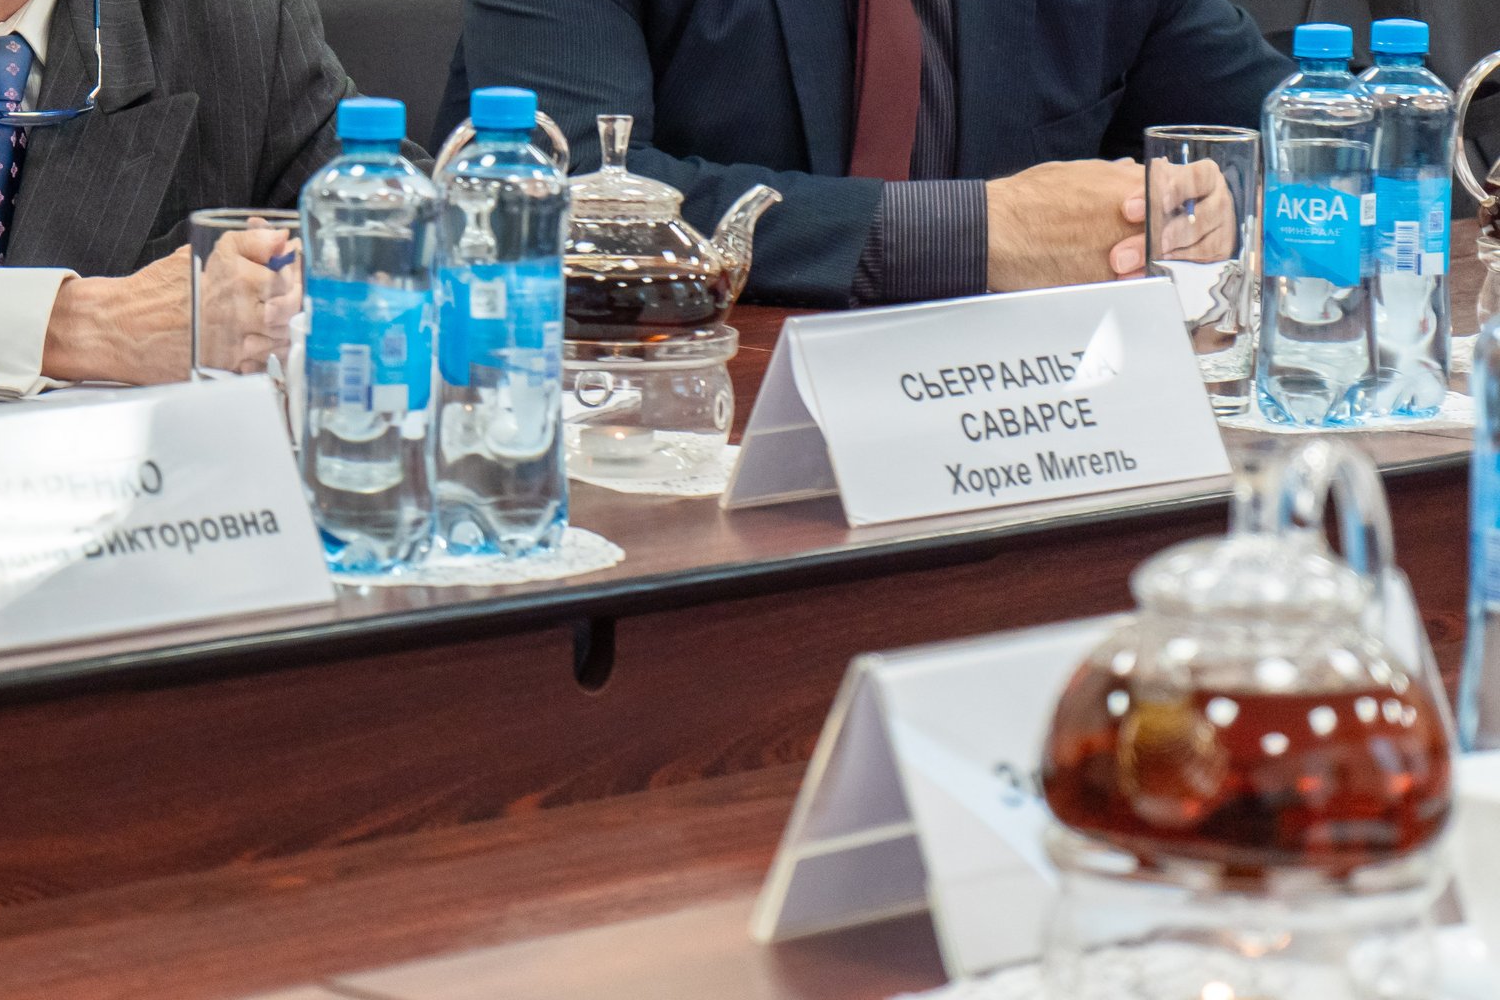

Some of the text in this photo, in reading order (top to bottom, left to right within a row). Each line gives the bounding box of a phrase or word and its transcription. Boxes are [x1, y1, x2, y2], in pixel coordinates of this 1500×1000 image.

[1276, 192, 1348, 225] АКВА
[900, 350, 1119, 402] СЬЕРРААЛЬ
[960, 397, 1097, 442] САВАРСЕ
[945, 448, 1137, 496] Хорхе Мигель
